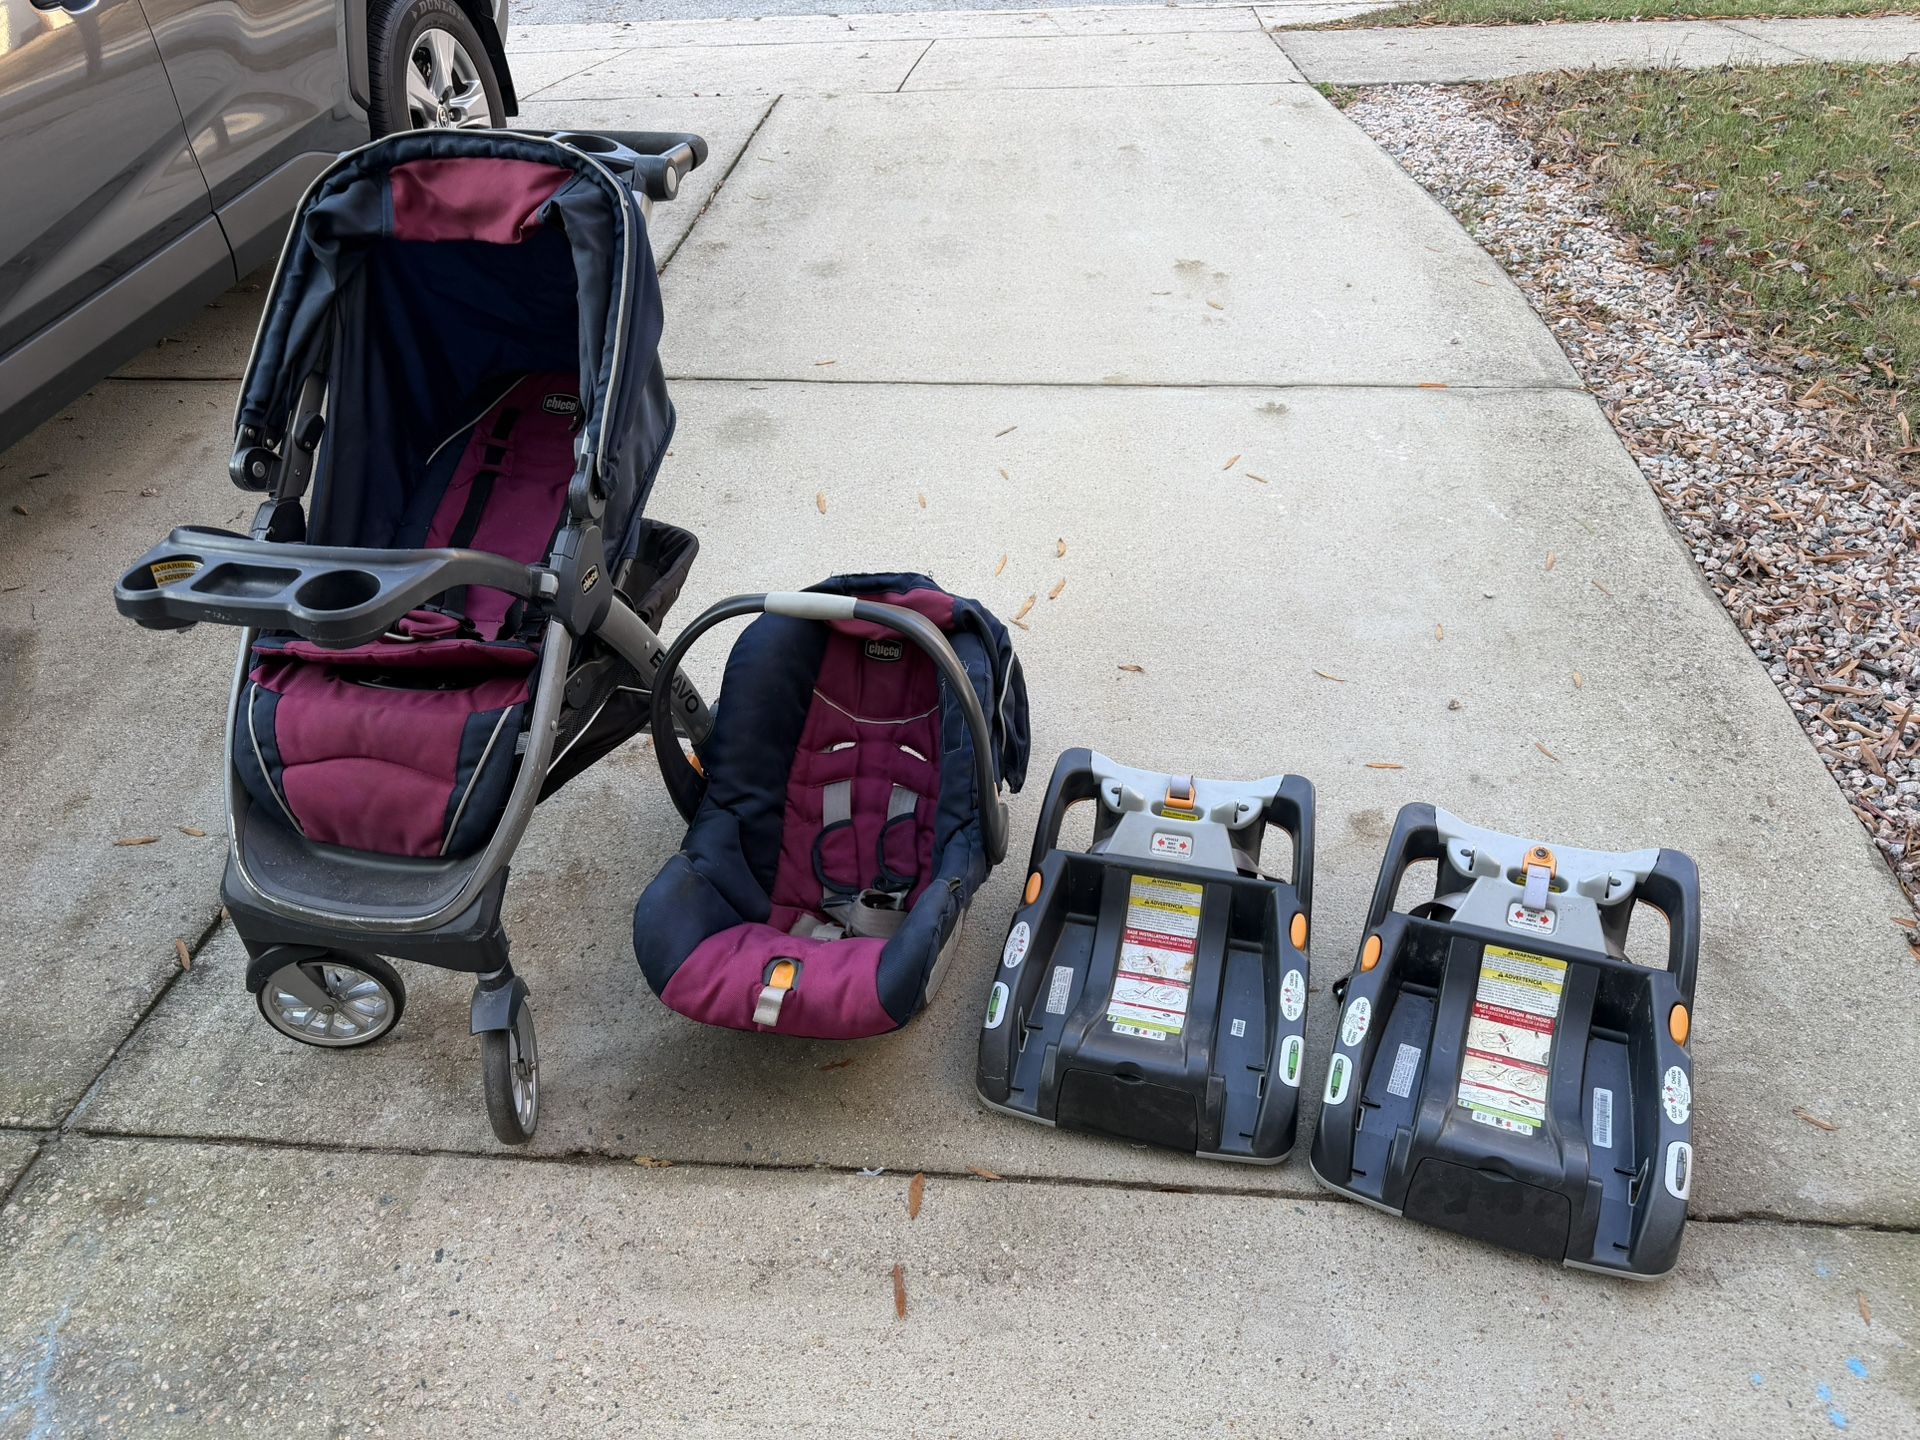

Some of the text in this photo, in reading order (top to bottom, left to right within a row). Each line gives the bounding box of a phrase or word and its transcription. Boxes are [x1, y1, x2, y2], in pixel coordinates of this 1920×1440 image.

[546, 396, 576, 410] chicco
[868, 642, 900, 658] chicco
[1150, 900, 1184, 910] ADVERTENCIA
[1514, 952, 1542, 962] WARNING
[1504, 972, 1542, 986] ADVERTENCIA
[1490, 1006, 1524, 1018] INSTALLATION
